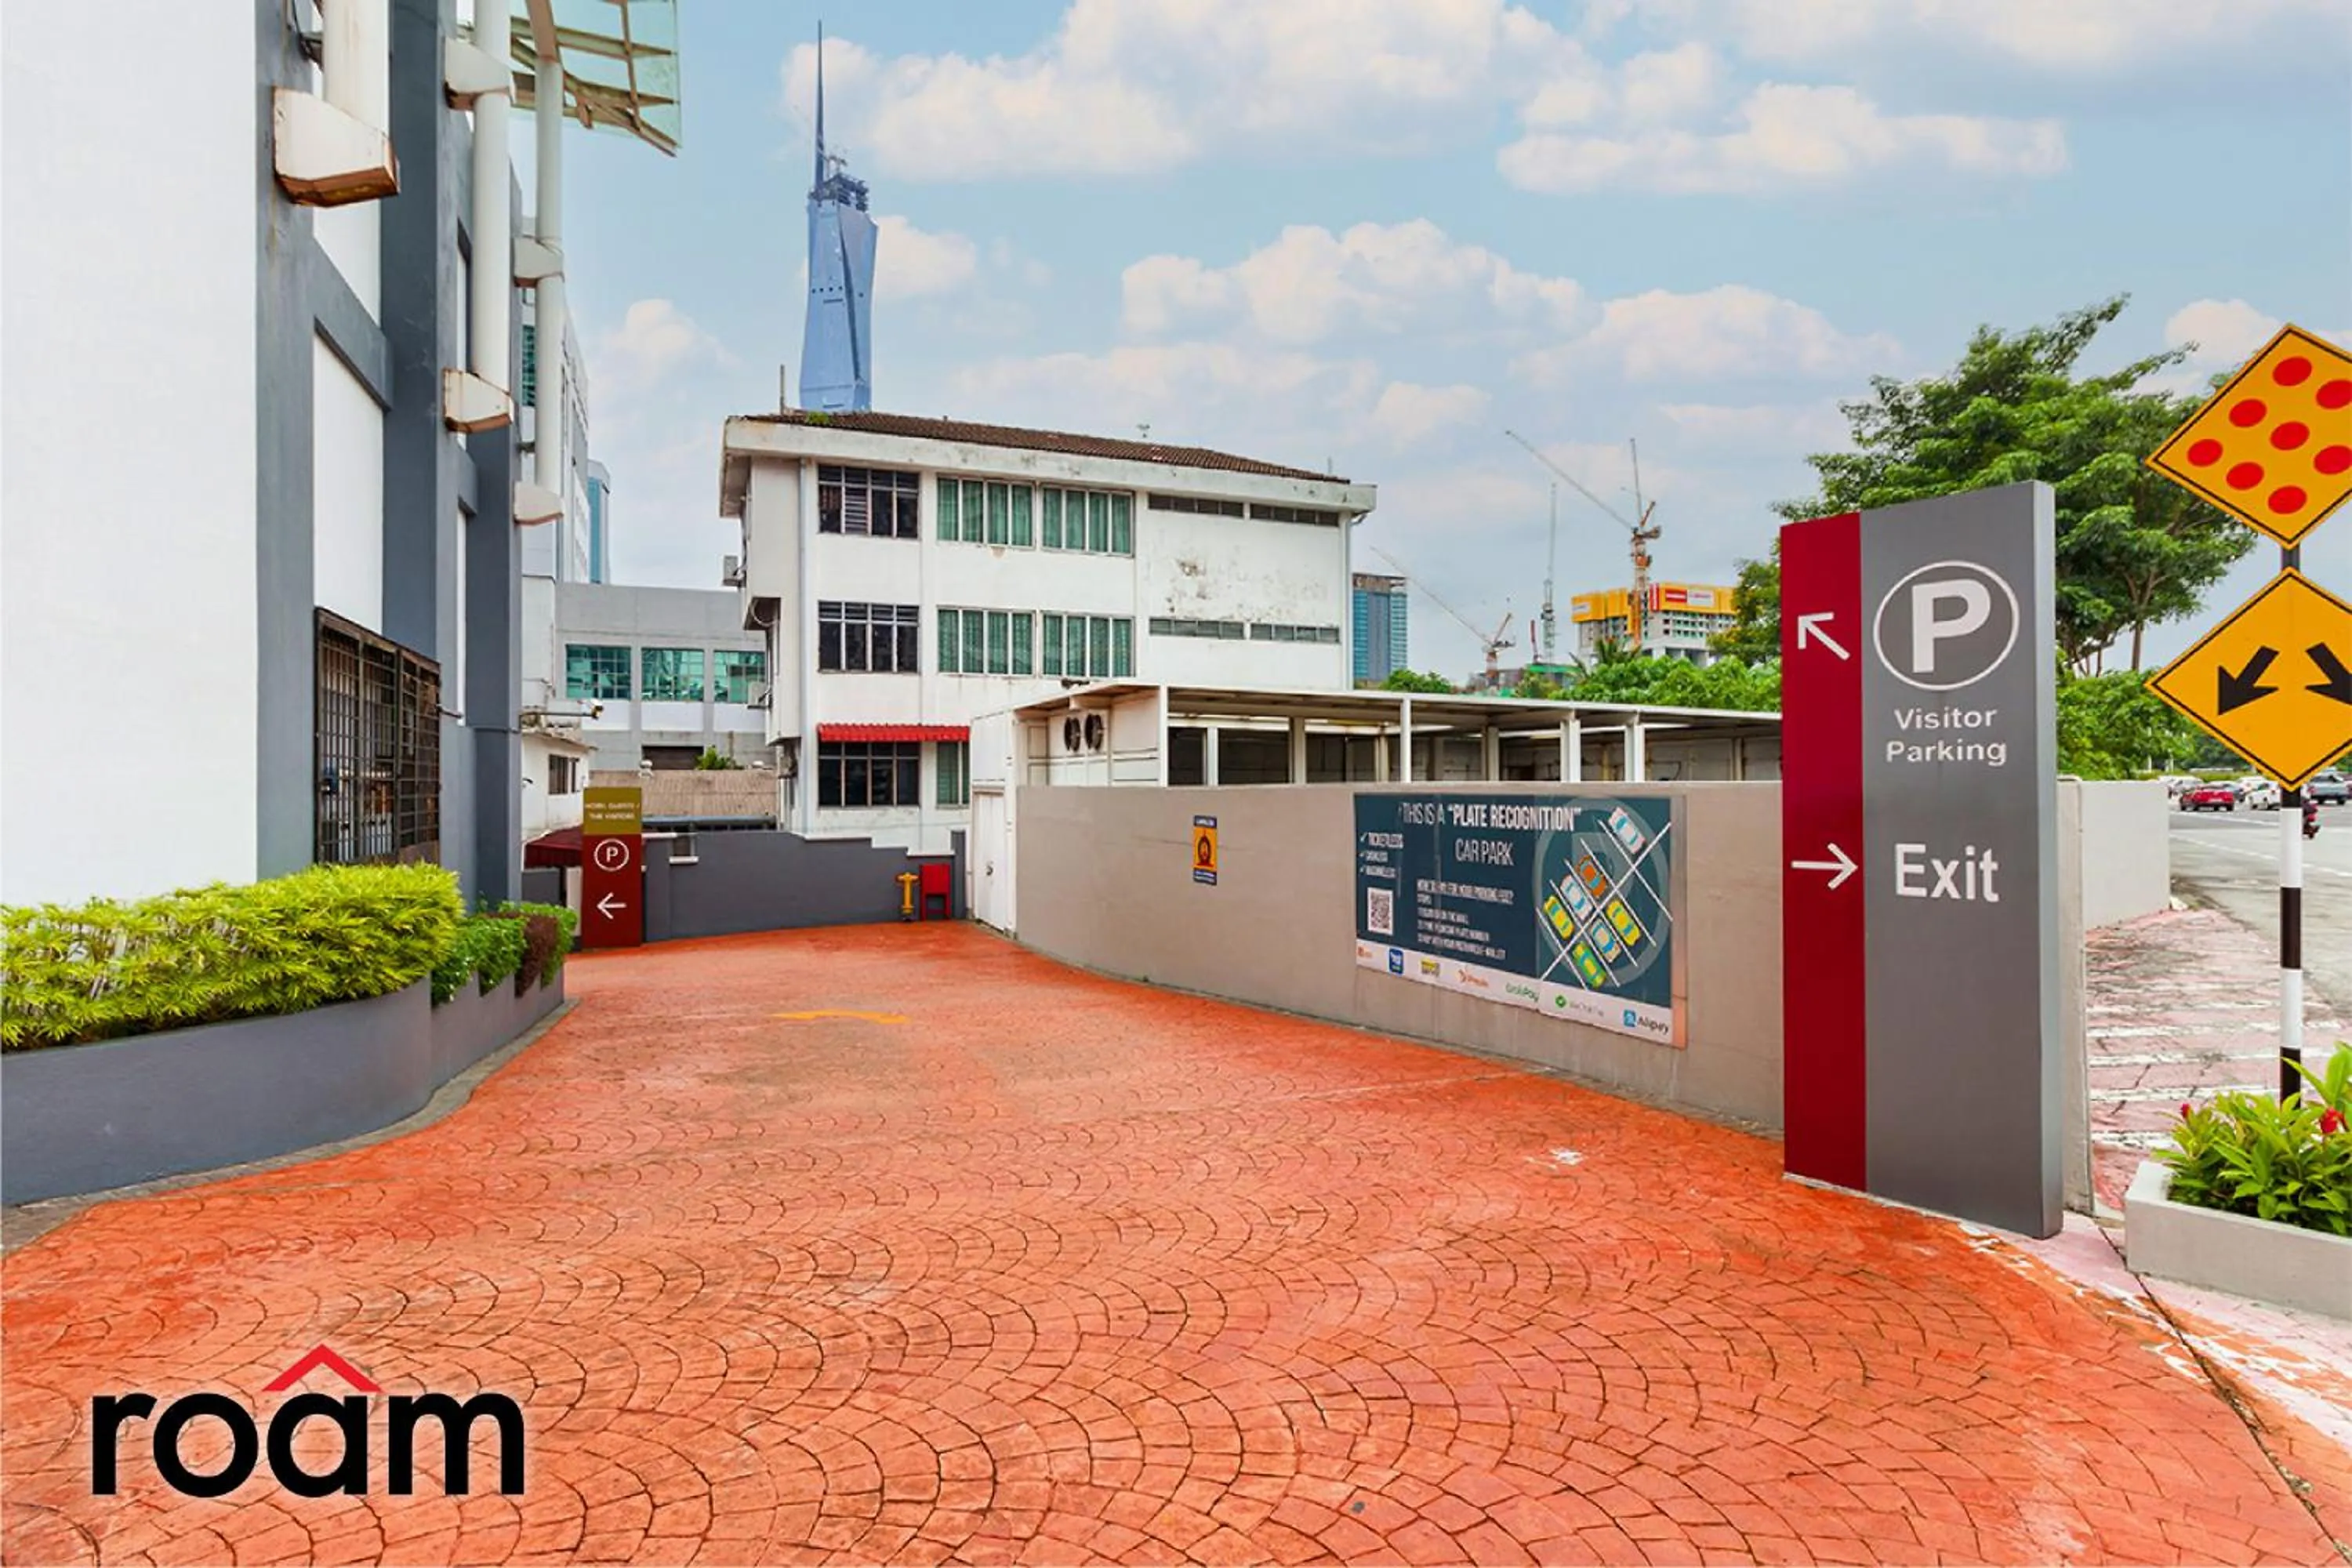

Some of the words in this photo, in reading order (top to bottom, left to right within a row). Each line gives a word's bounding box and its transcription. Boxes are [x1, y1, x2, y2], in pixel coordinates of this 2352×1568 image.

[1912, 579, 1991, 673] P
[1894, 707, 1998, 731] Visitor
[1886, 739, 2008, 767] Parking
[1437, 803, 1446, 825] A
[606, 847, 619, 862] P
[1454, 837, 1479, 862] CAR
[1480, 840, 1515, 866] PARK
[1894, 843, 2001, 903] Exit
